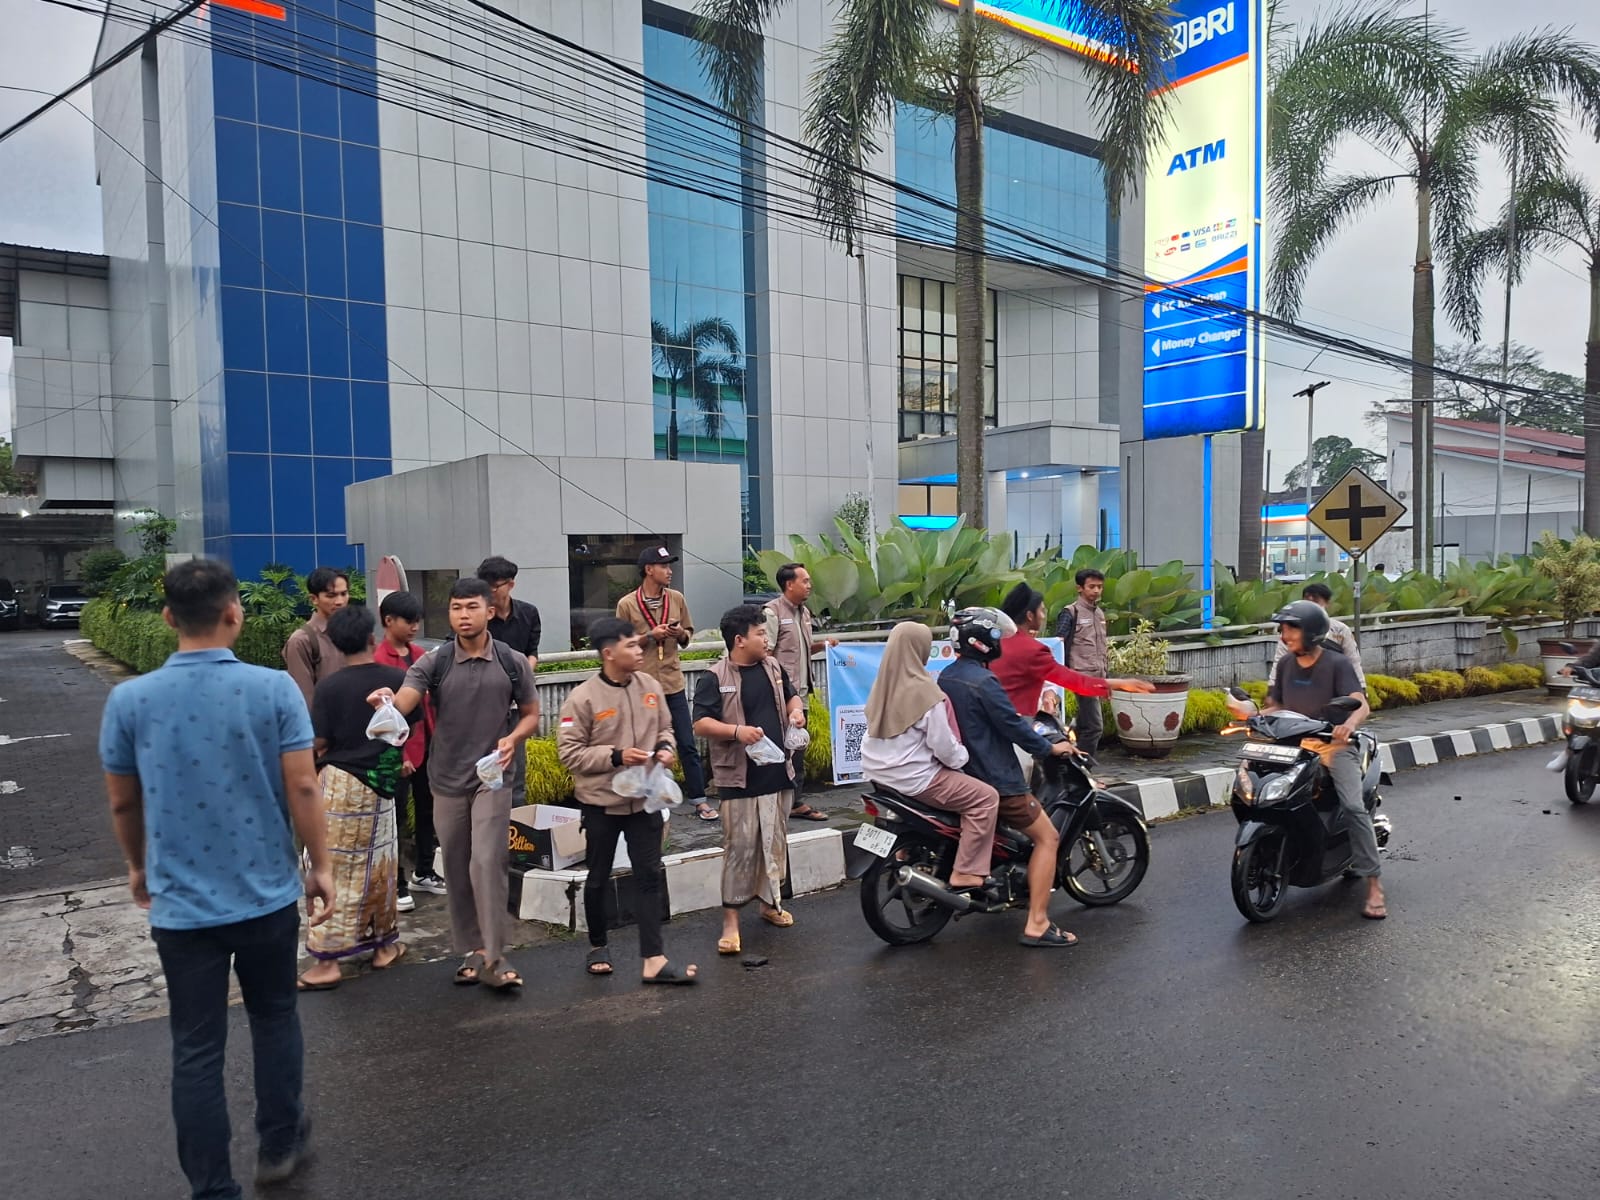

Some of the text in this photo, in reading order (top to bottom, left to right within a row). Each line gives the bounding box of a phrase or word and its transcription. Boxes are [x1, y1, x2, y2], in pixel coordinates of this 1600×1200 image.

[1188, 1, 1234, 49] BRI
[1166, 138, 1225, 176] ATM
[1193, 226, 1210, 237] VISA
[1162, 328, 1242, 348] Money Changer
